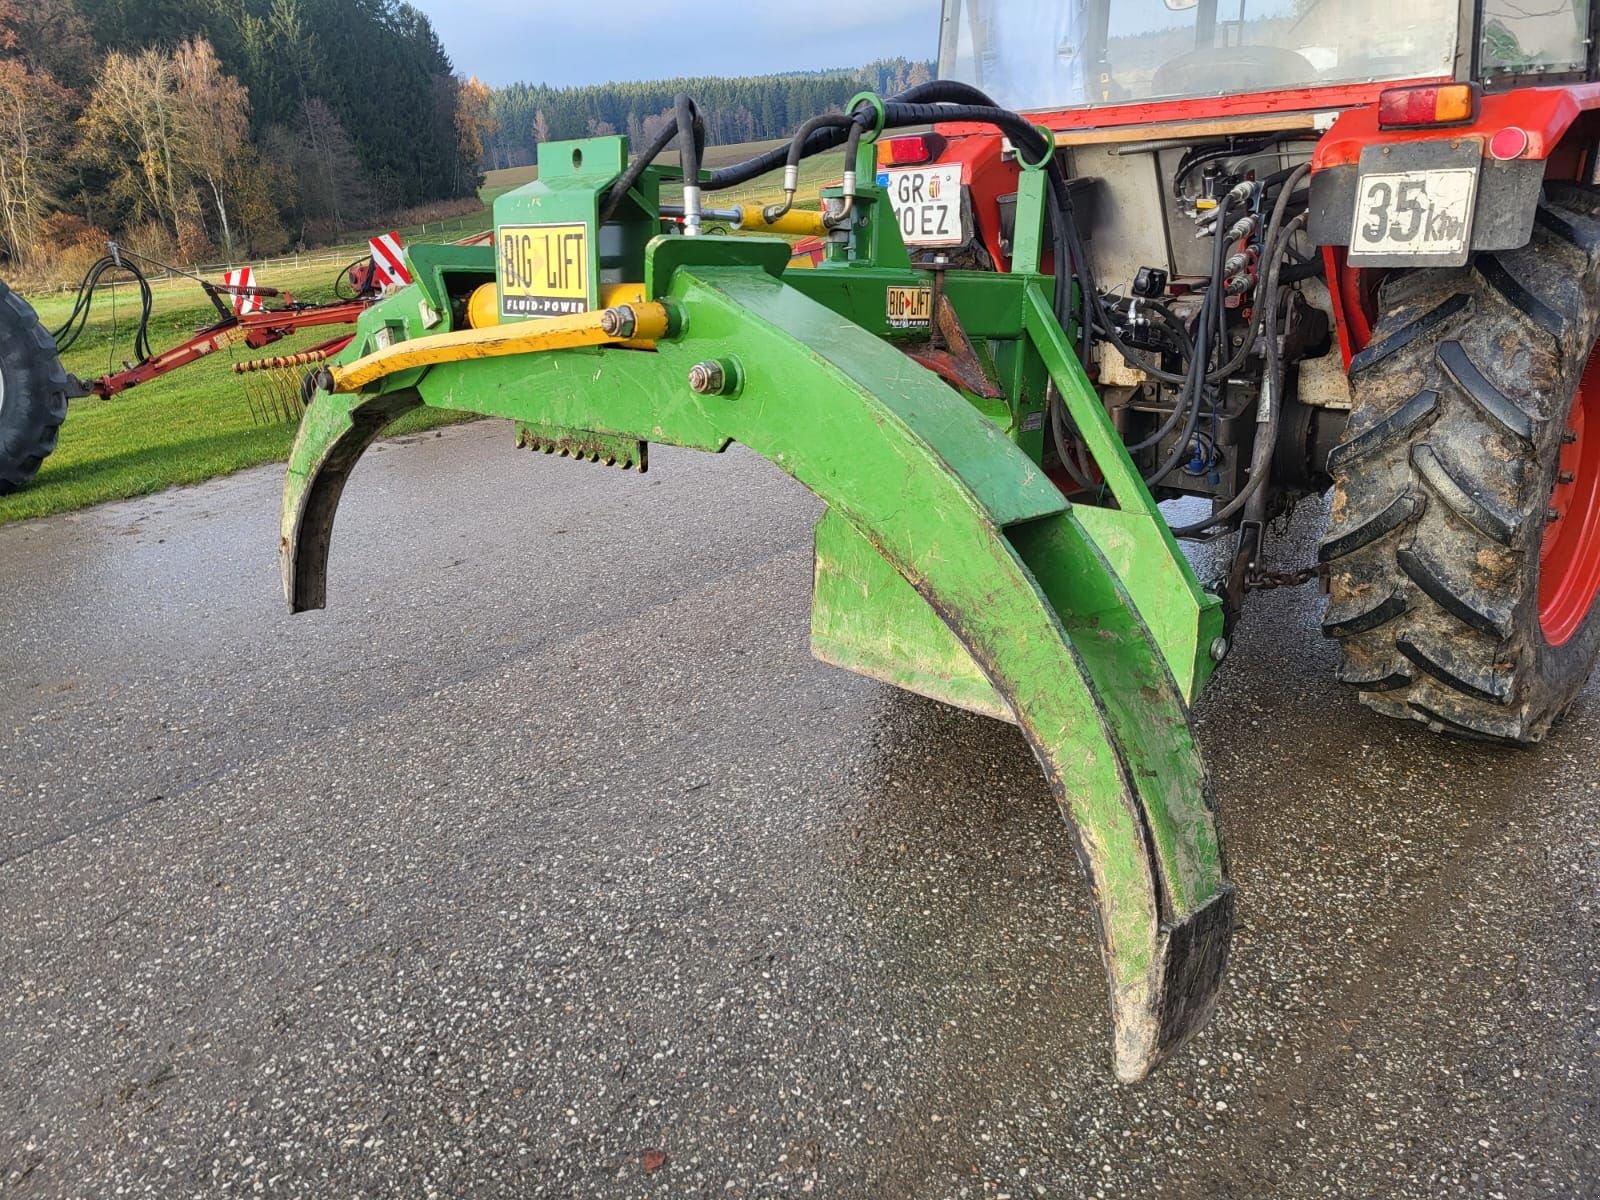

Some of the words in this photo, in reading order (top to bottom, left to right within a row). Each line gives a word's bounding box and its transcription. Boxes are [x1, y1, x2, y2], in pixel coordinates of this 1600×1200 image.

[898, 174, 924, 203] GR
[921, 205, 949, 235] EZ
[504, 234, 533, 288] BIG
[545, 233, 584, 290] LIFT
[506, 300, 585, 314] FLUID-POWER
[889, 291, 905, 316] BIG
[910, 291, 930, 316] LIFT
